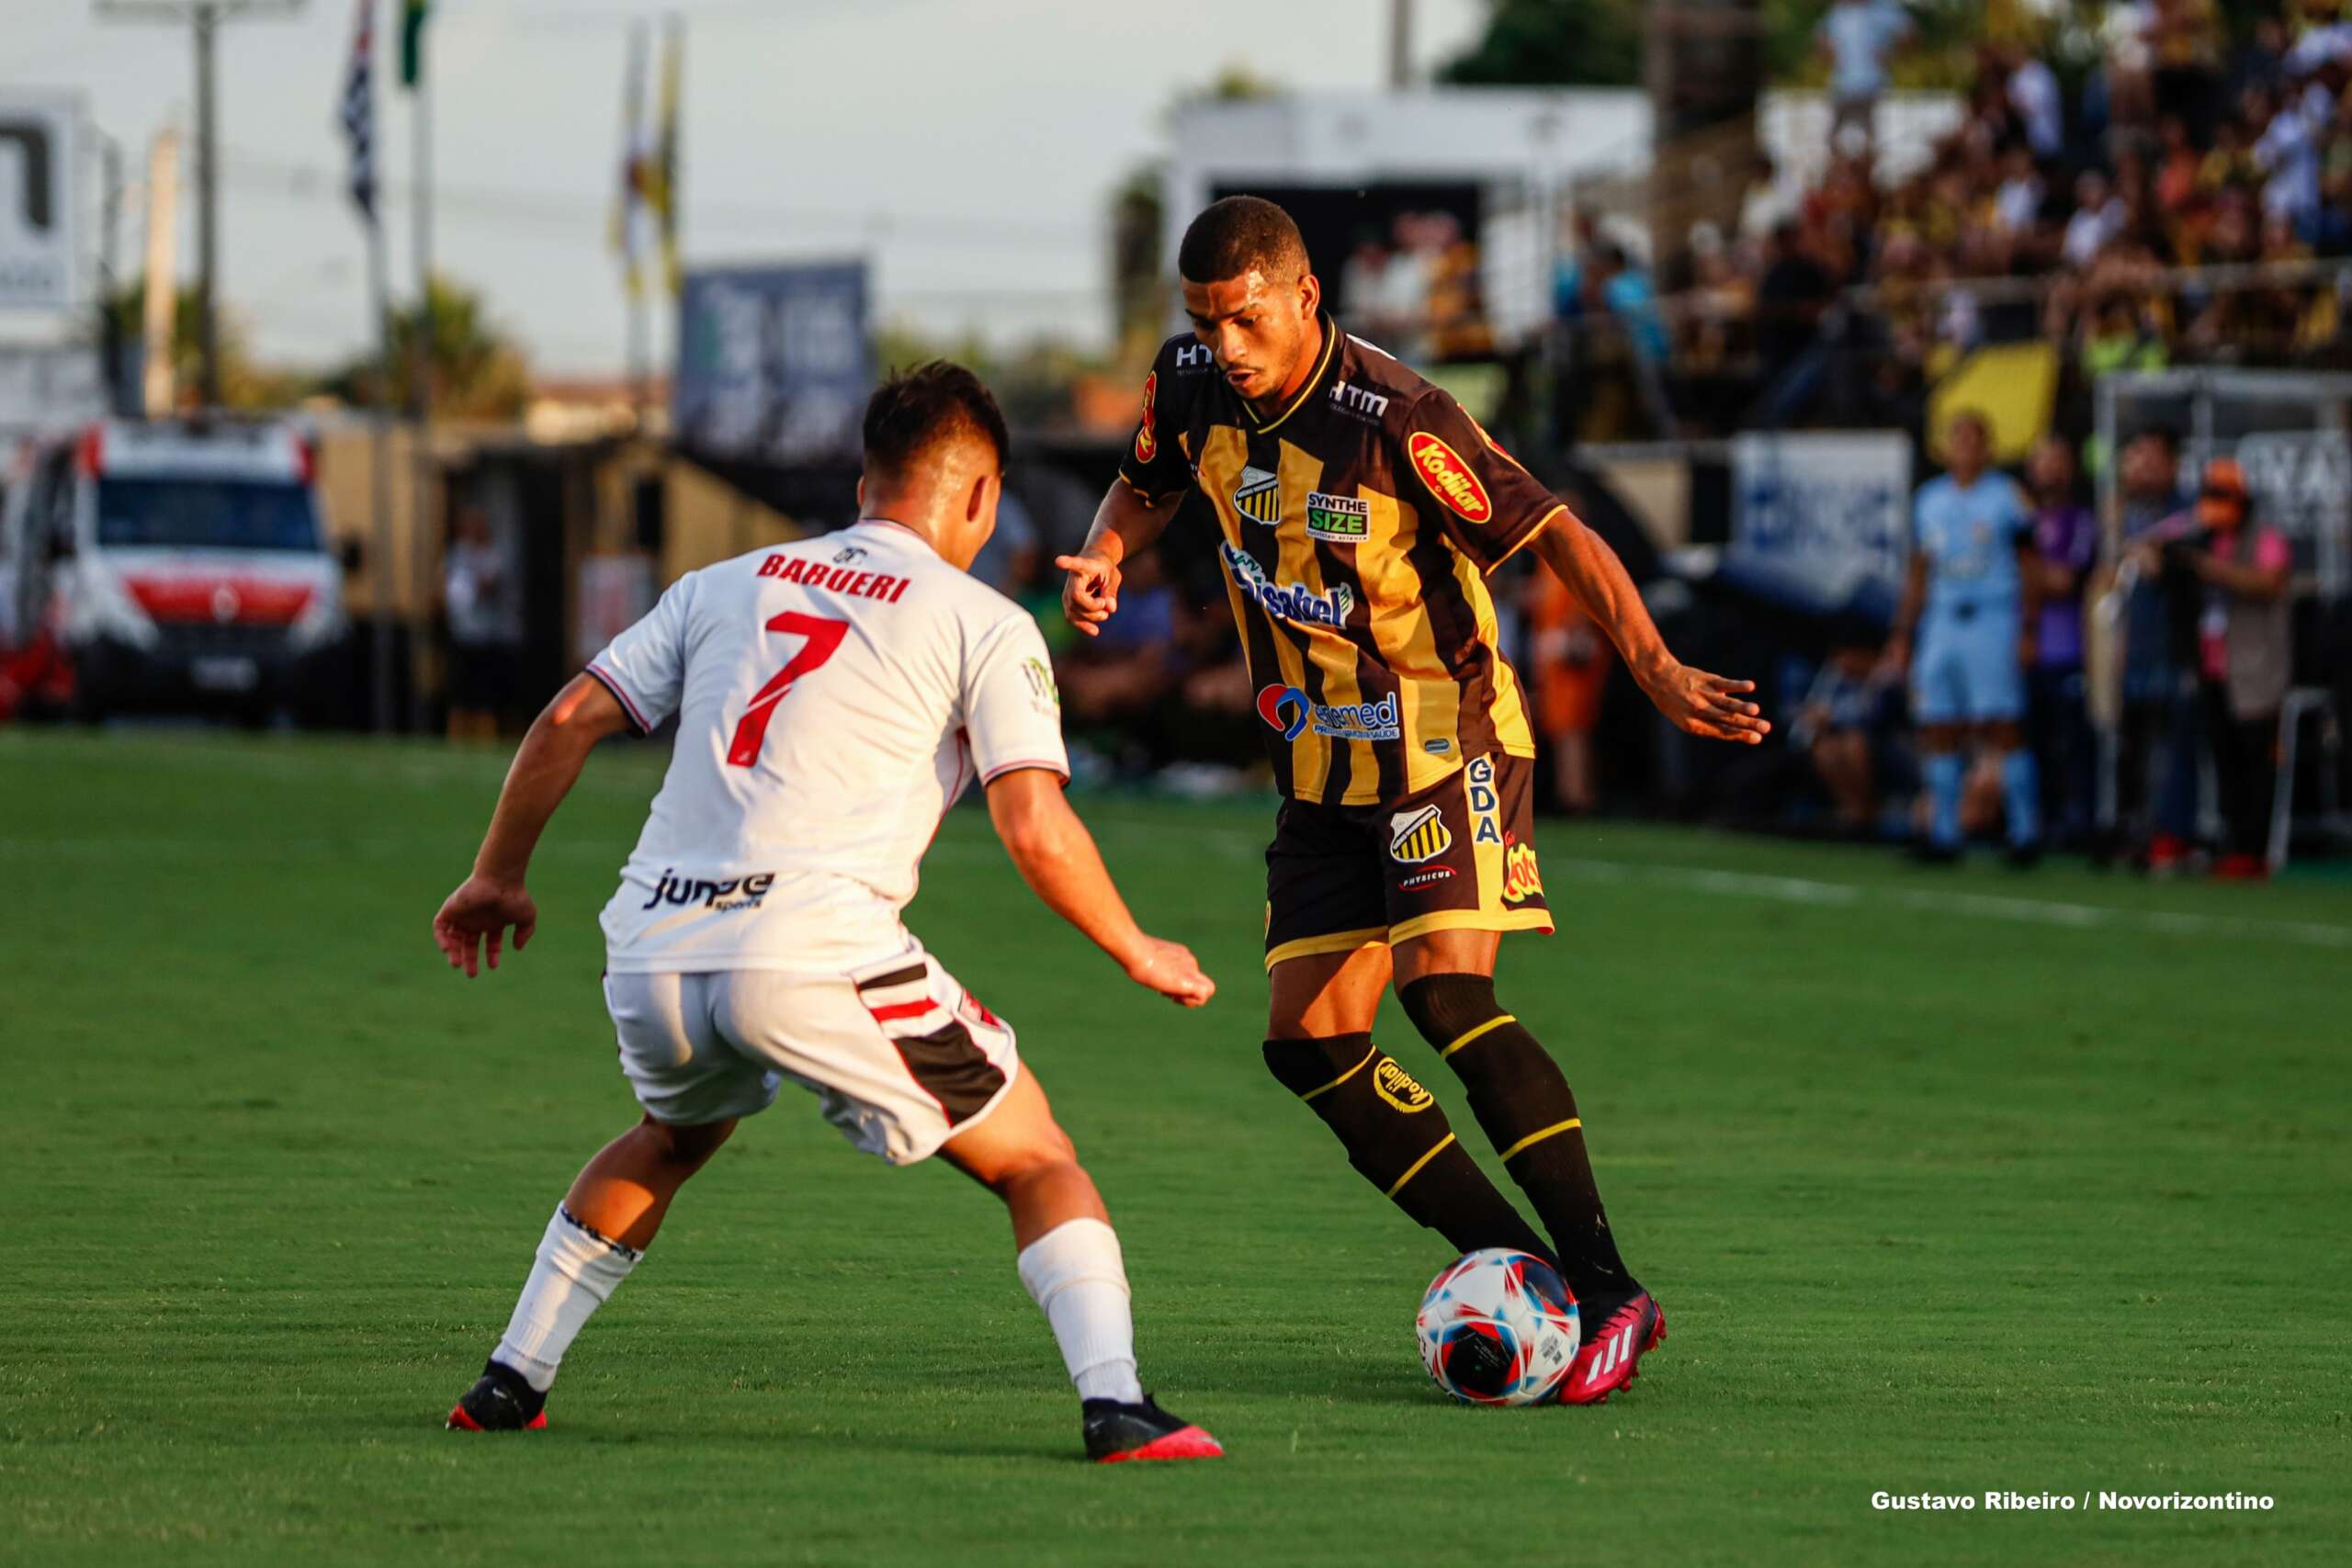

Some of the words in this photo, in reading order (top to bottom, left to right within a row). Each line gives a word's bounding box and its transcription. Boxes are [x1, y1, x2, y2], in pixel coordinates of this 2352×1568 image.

[1307, 493, 1368, 513] SYNTHE
[1416, 443, 1485, 513] Kodilar
[1311, 509, 1363, 534] SIZE
[756, 554, 911, 604] BARUERI
[727, 611, 850, 768] 7
[1470, 758, 1501, 844] GDA
[1403, 870, 1452, 887] PHYSICUS
